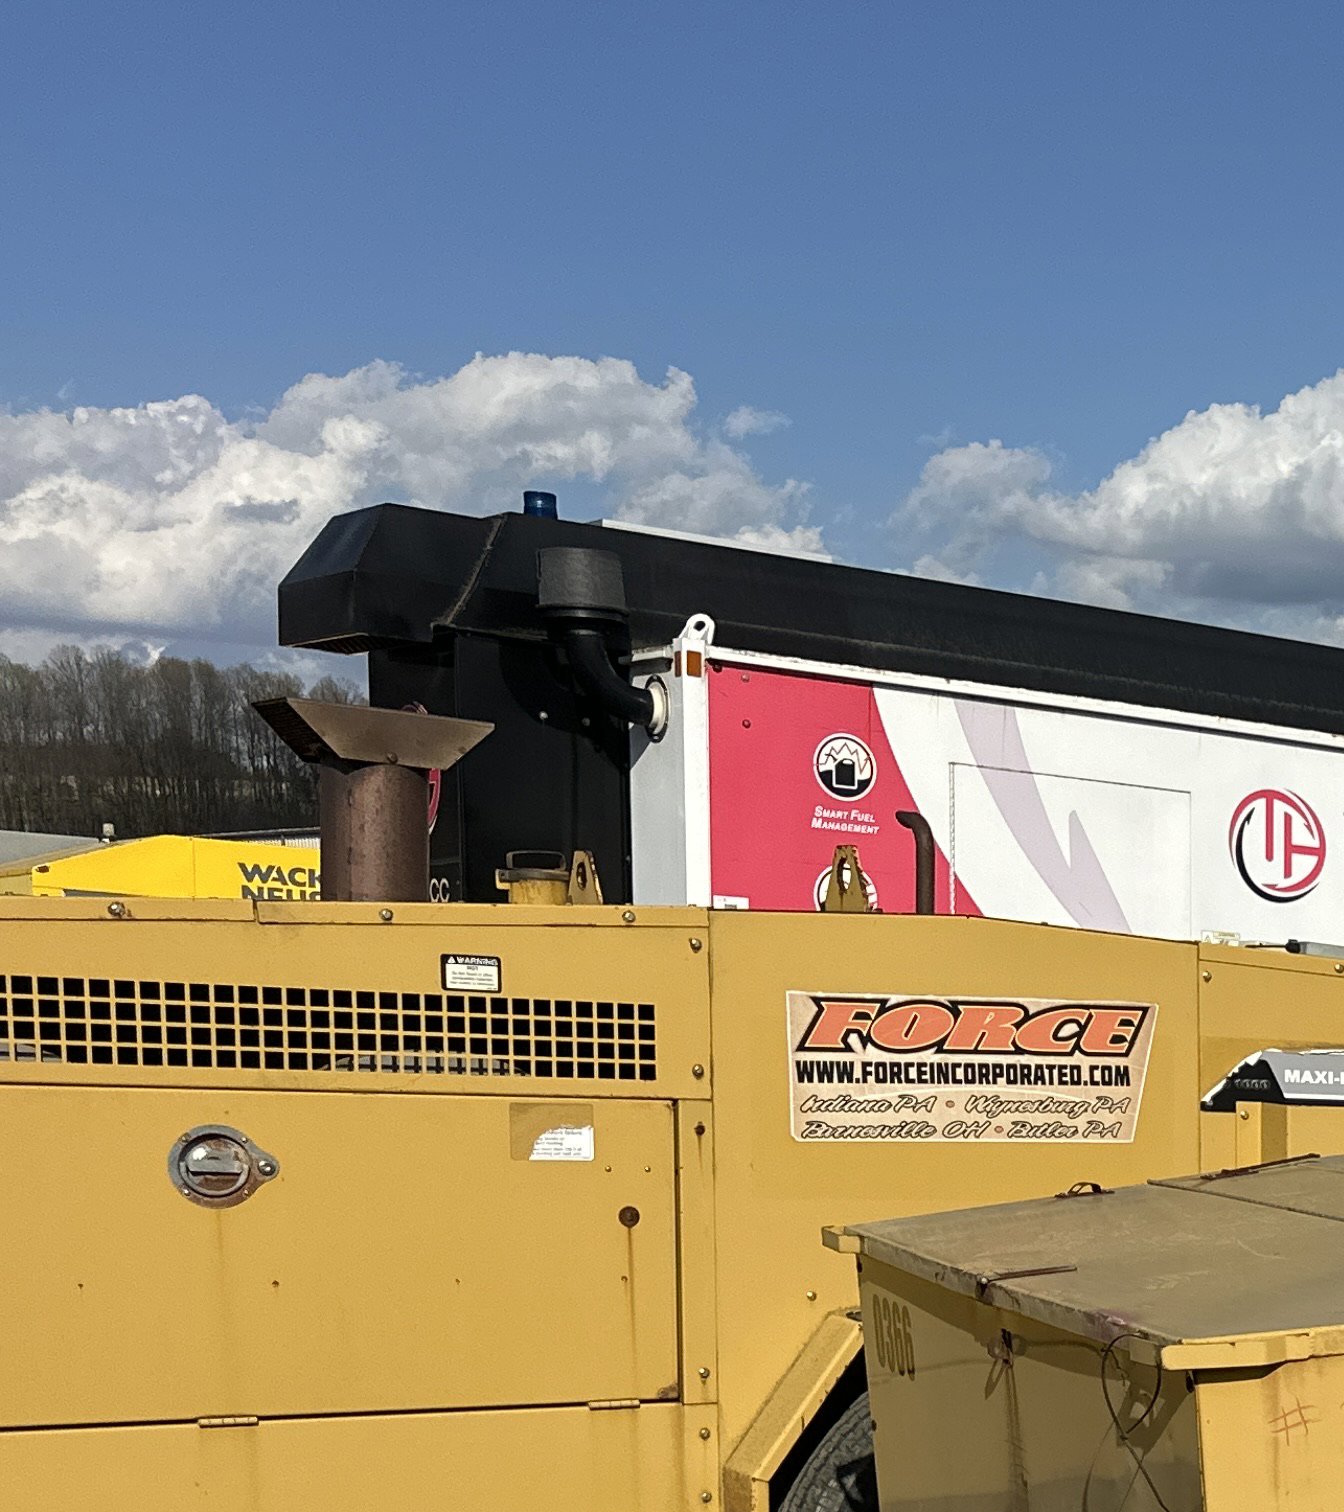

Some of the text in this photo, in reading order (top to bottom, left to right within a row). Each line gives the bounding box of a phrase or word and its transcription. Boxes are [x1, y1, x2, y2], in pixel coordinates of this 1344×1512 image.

[811, 817, 880, 835] MANAGEMENT
[814, 805, 876, 824] SMART FUEL
[237, 862, 320, 888] WACK
[796, 997, 1150, 1057] FORCE
[795, 1060, 1131, 1087] WWW.FORCEINCORPORATED.COM
[800, 1095, 892, 1113] Indiana
[894, 1094, 937, 1113] PA
[1092, 1096, 1132, 1114] PA
[942, 1120, 992, 1138] OH
[1007, 1121, 1079, 1139] Butler
[1082, 1120, 1123, 1139] PA
[873, 1294, 915, 1381] 0366
